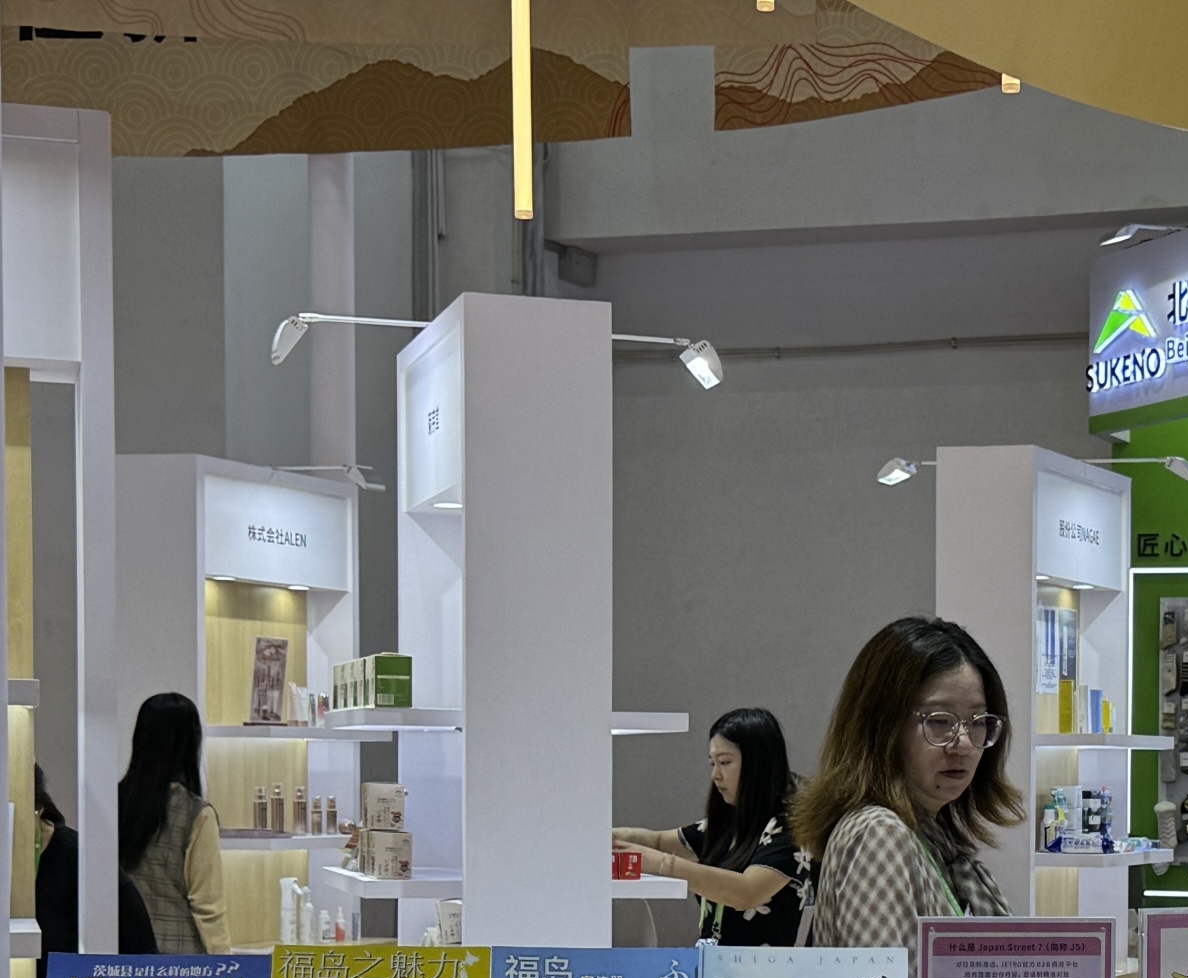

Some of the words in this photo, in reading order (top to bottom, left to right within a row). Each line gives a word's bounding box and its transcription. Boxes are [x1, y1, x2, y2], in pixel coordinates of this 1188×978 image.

[1085, 349, 1162, 393] SUKENO
[248, 524, 307, 548] 株式会社ALEN
[977, 943, 1005, 952] Japan
[717, 954, 795, 964] SHIGA
[818, 955, 895, 965] JAPAN
